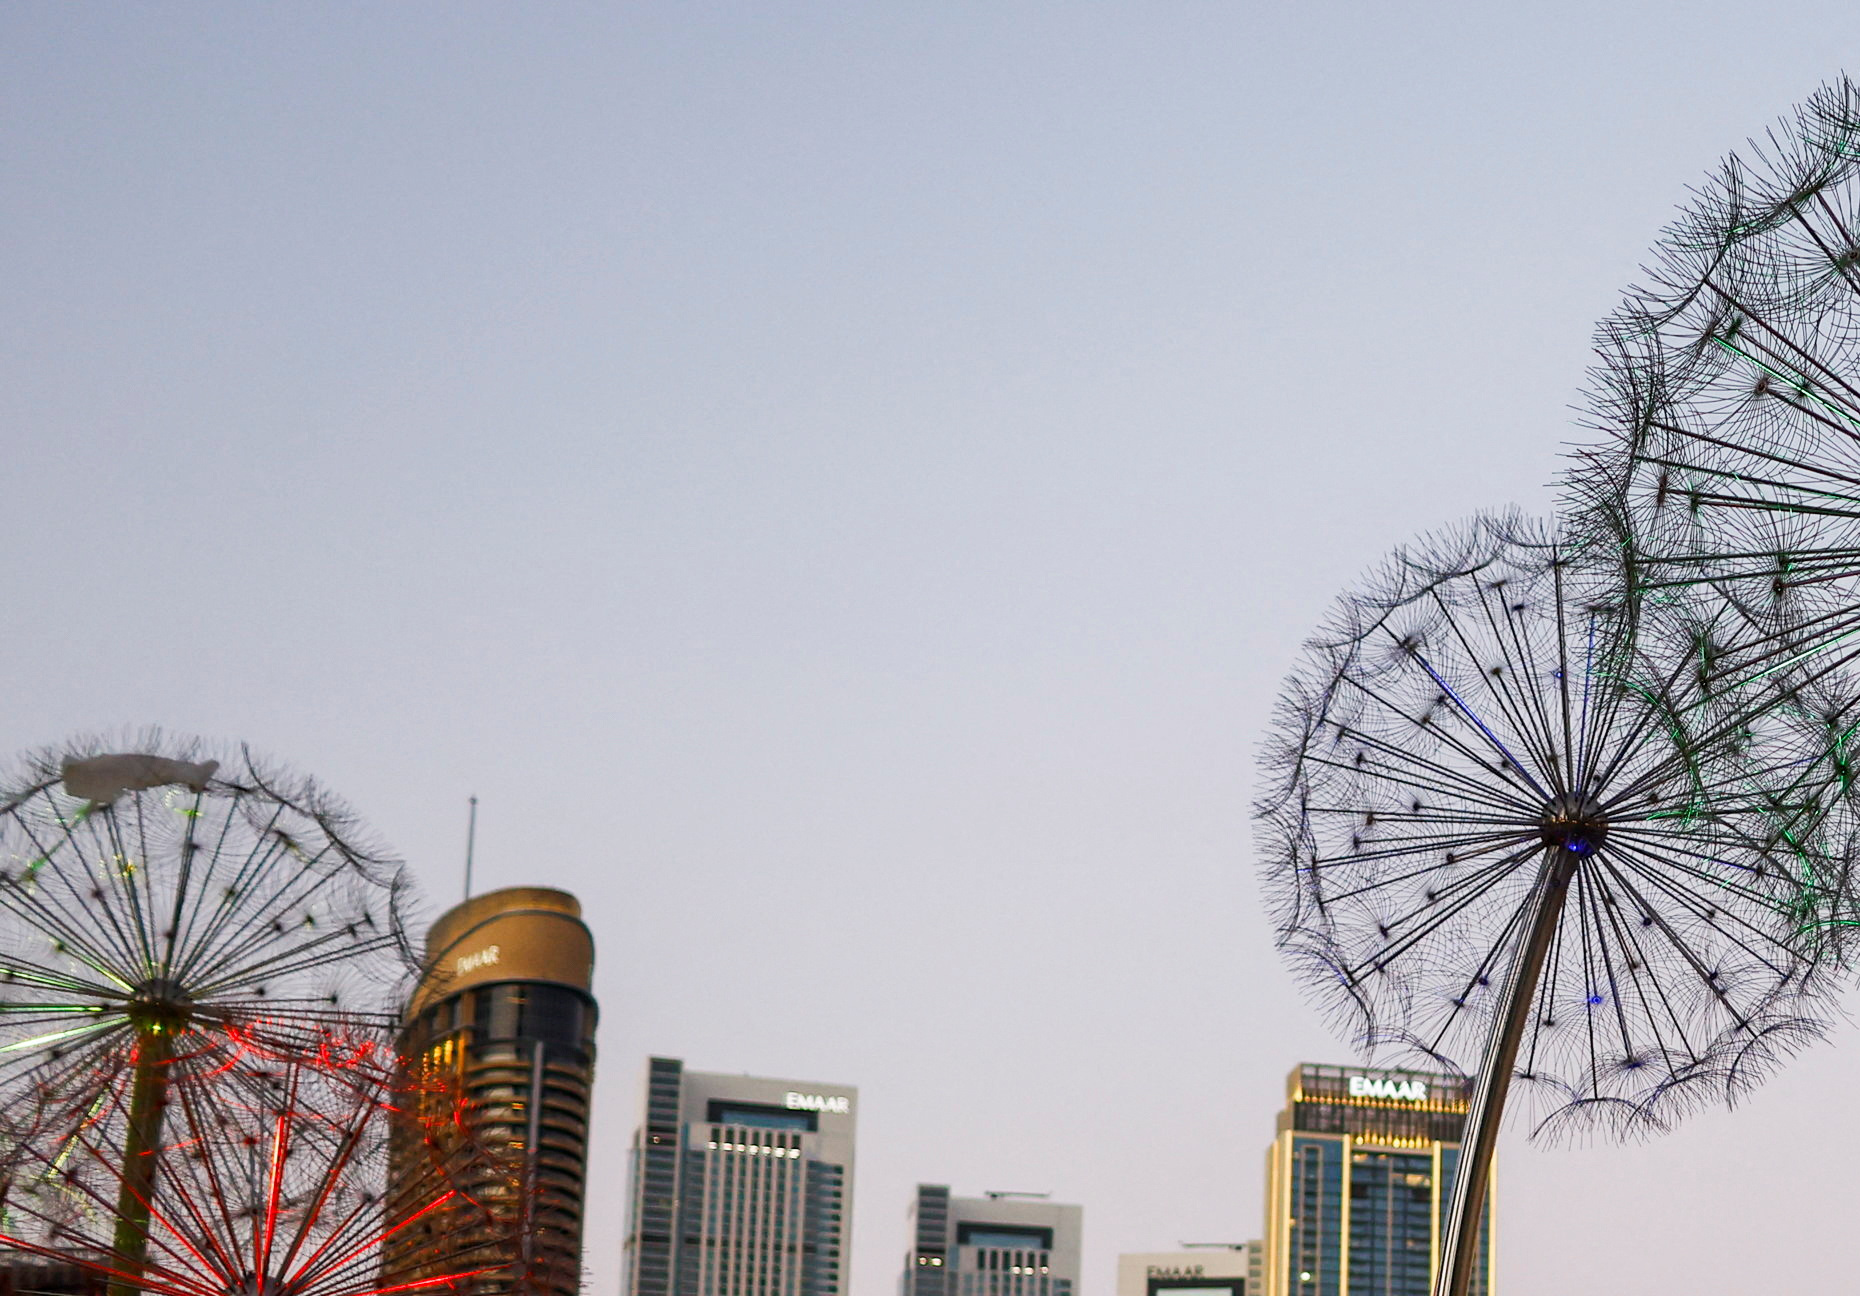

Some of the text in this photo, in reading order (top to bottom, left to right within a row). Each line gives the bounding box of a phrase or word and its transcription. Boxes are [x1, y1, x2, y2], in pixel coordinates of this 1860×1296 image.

[457, 945, 500, 976] EMAAR
[1349, 1076, 1427, 1102] EMAAR
[786, 1091, 849, 1114] EMAAR
[1147, 1265, 1204, 1281] EMAAR
